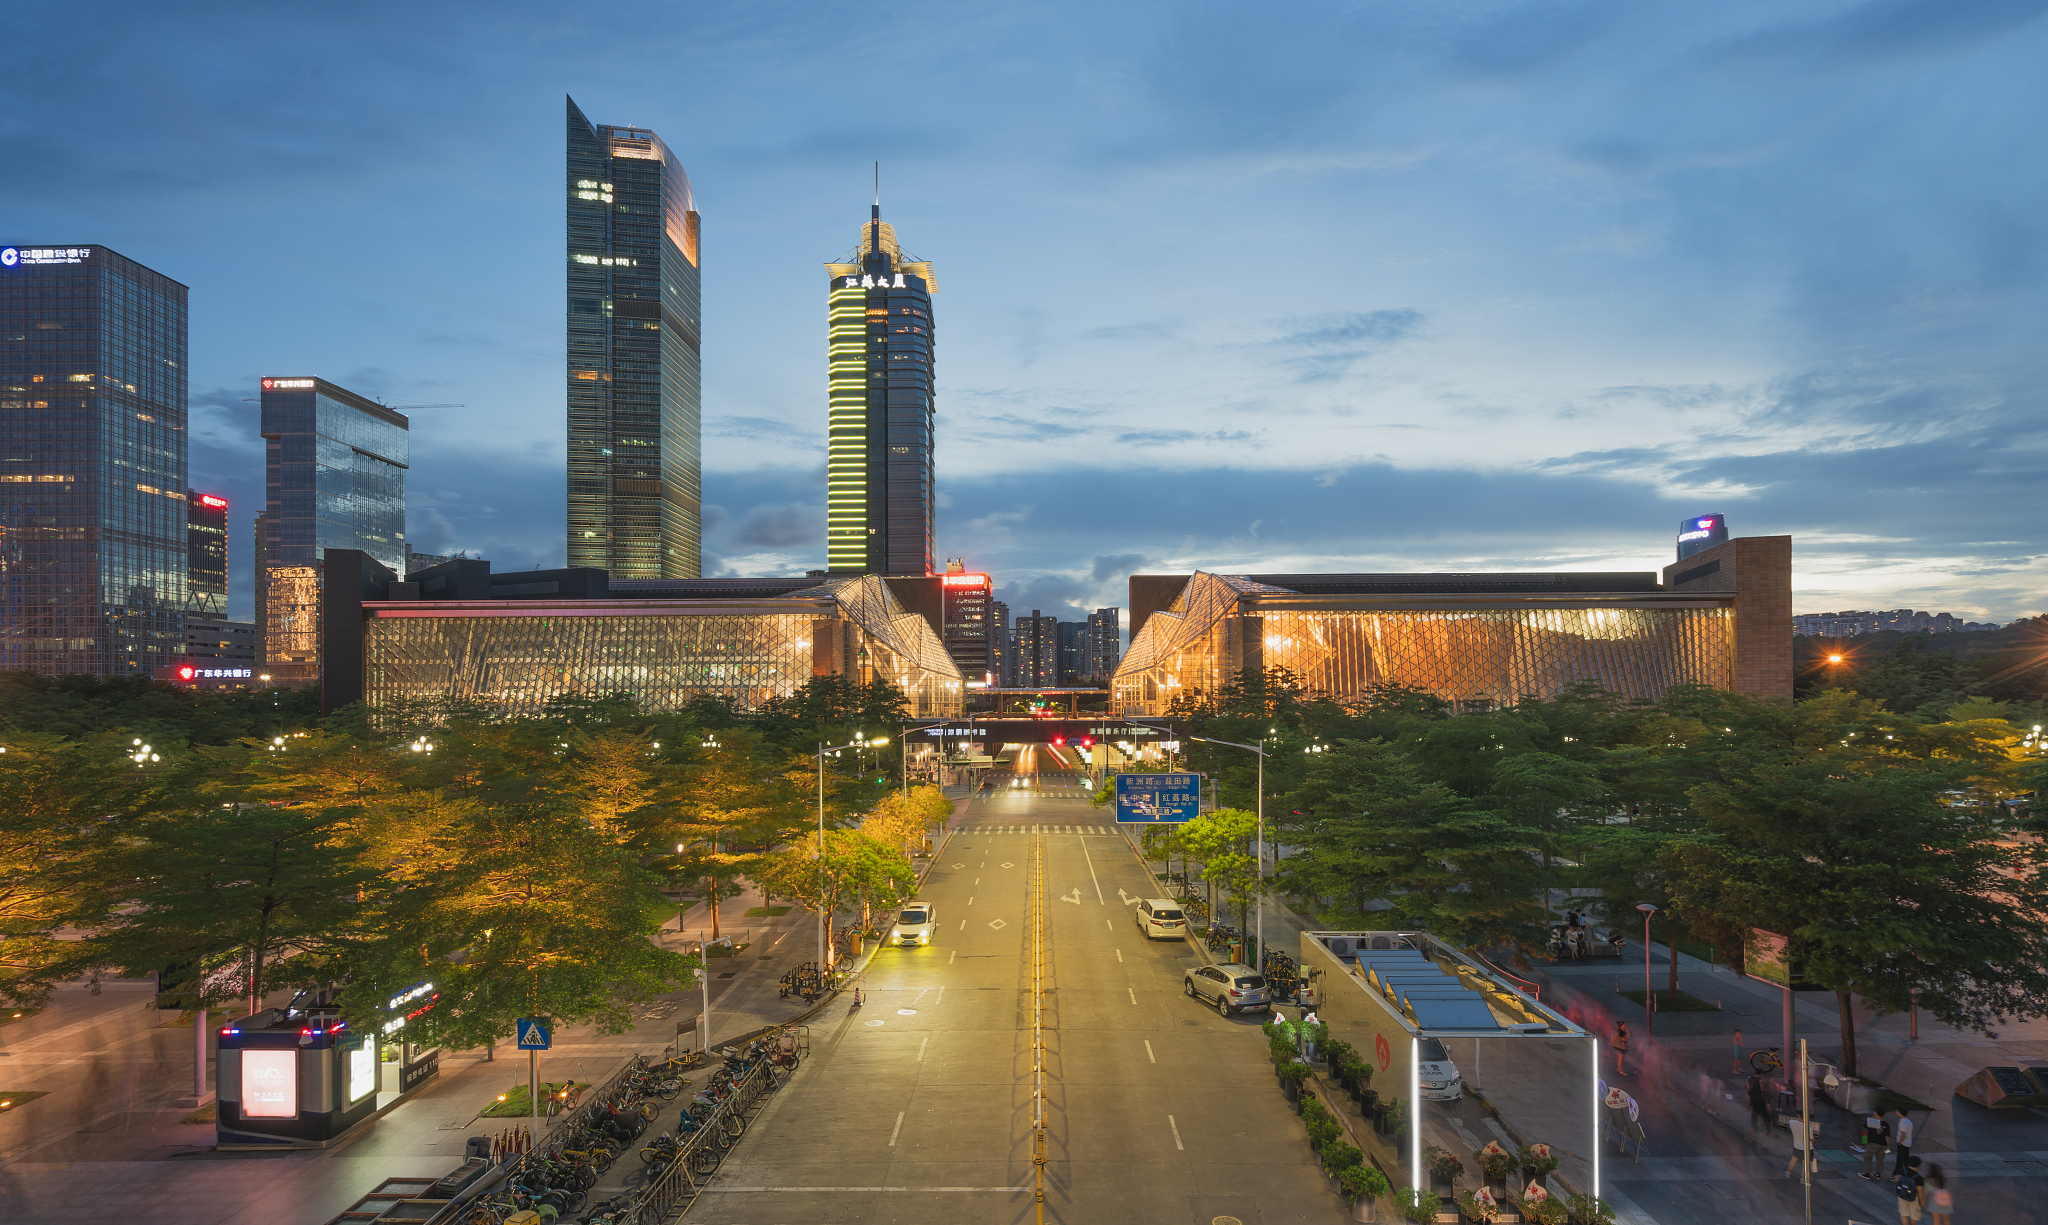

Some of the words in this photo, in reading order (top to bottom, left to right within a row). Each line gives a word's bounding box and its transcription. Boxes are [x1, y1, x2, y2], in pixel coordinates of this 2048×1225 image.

[20, 249, 90, 258] 中国建设银行
[194, 669, 251, 677] 广东华兴银行
